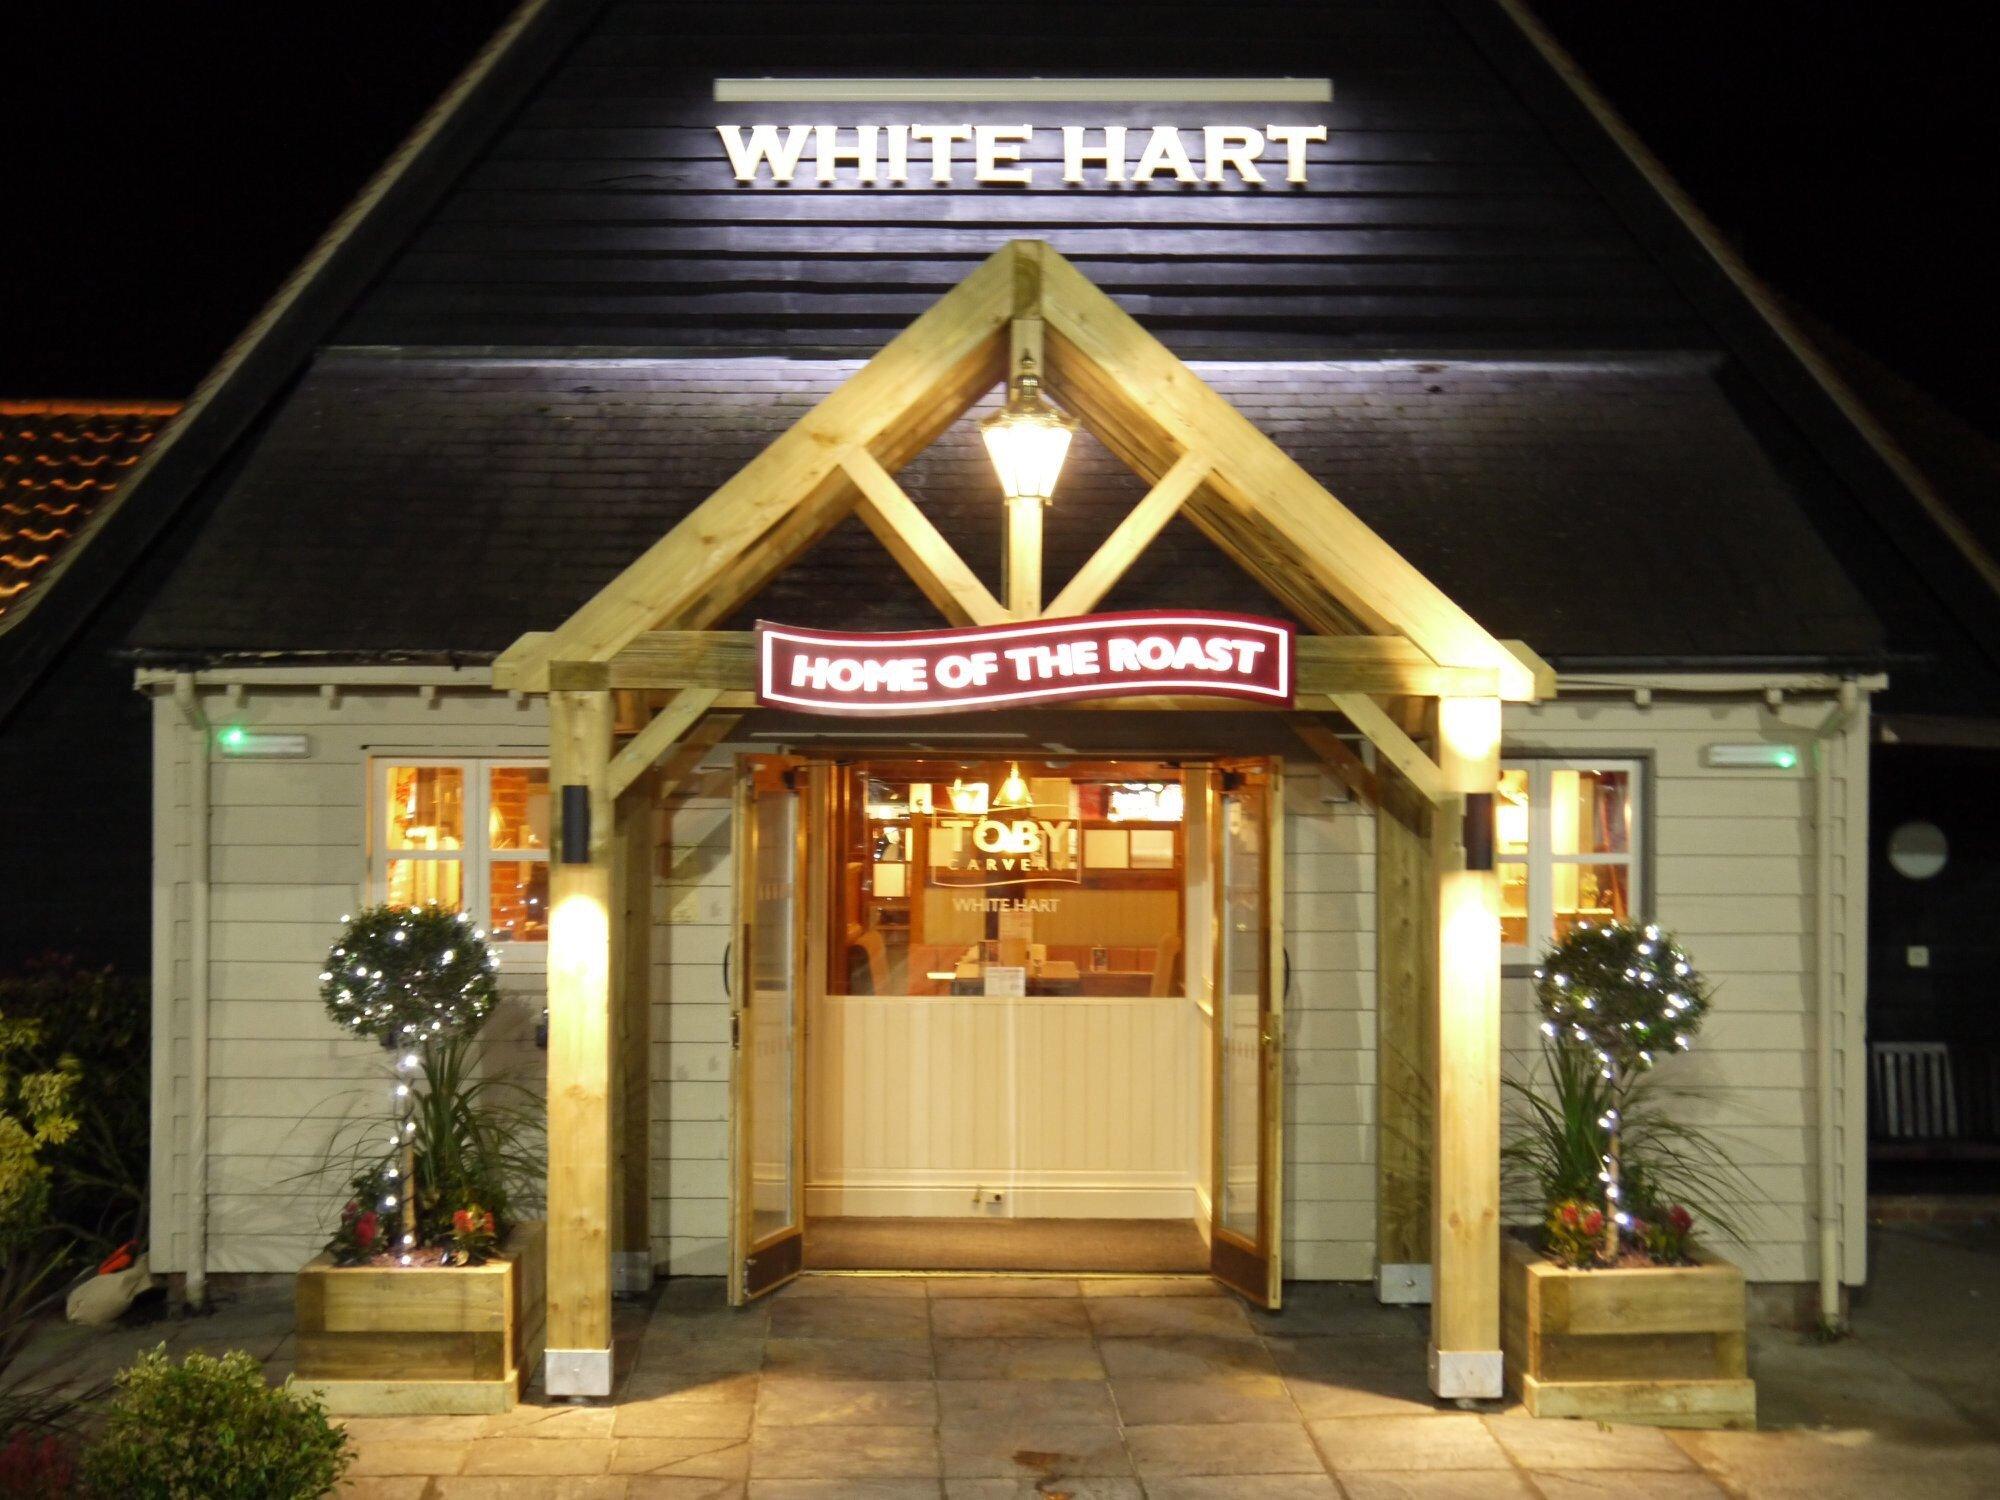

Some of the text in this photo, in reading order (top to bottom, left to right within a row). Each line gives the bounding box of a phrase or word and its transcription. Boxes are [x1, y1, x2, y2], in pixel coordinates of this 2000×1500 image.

[716, 123, 1327, 184] WHITE HART
[790, 636, 1266, 692] HOME OF THE ROAST
[940, 819, 1071, 853] TOBY
[953, 898, 1060, 912] WHITE HART
